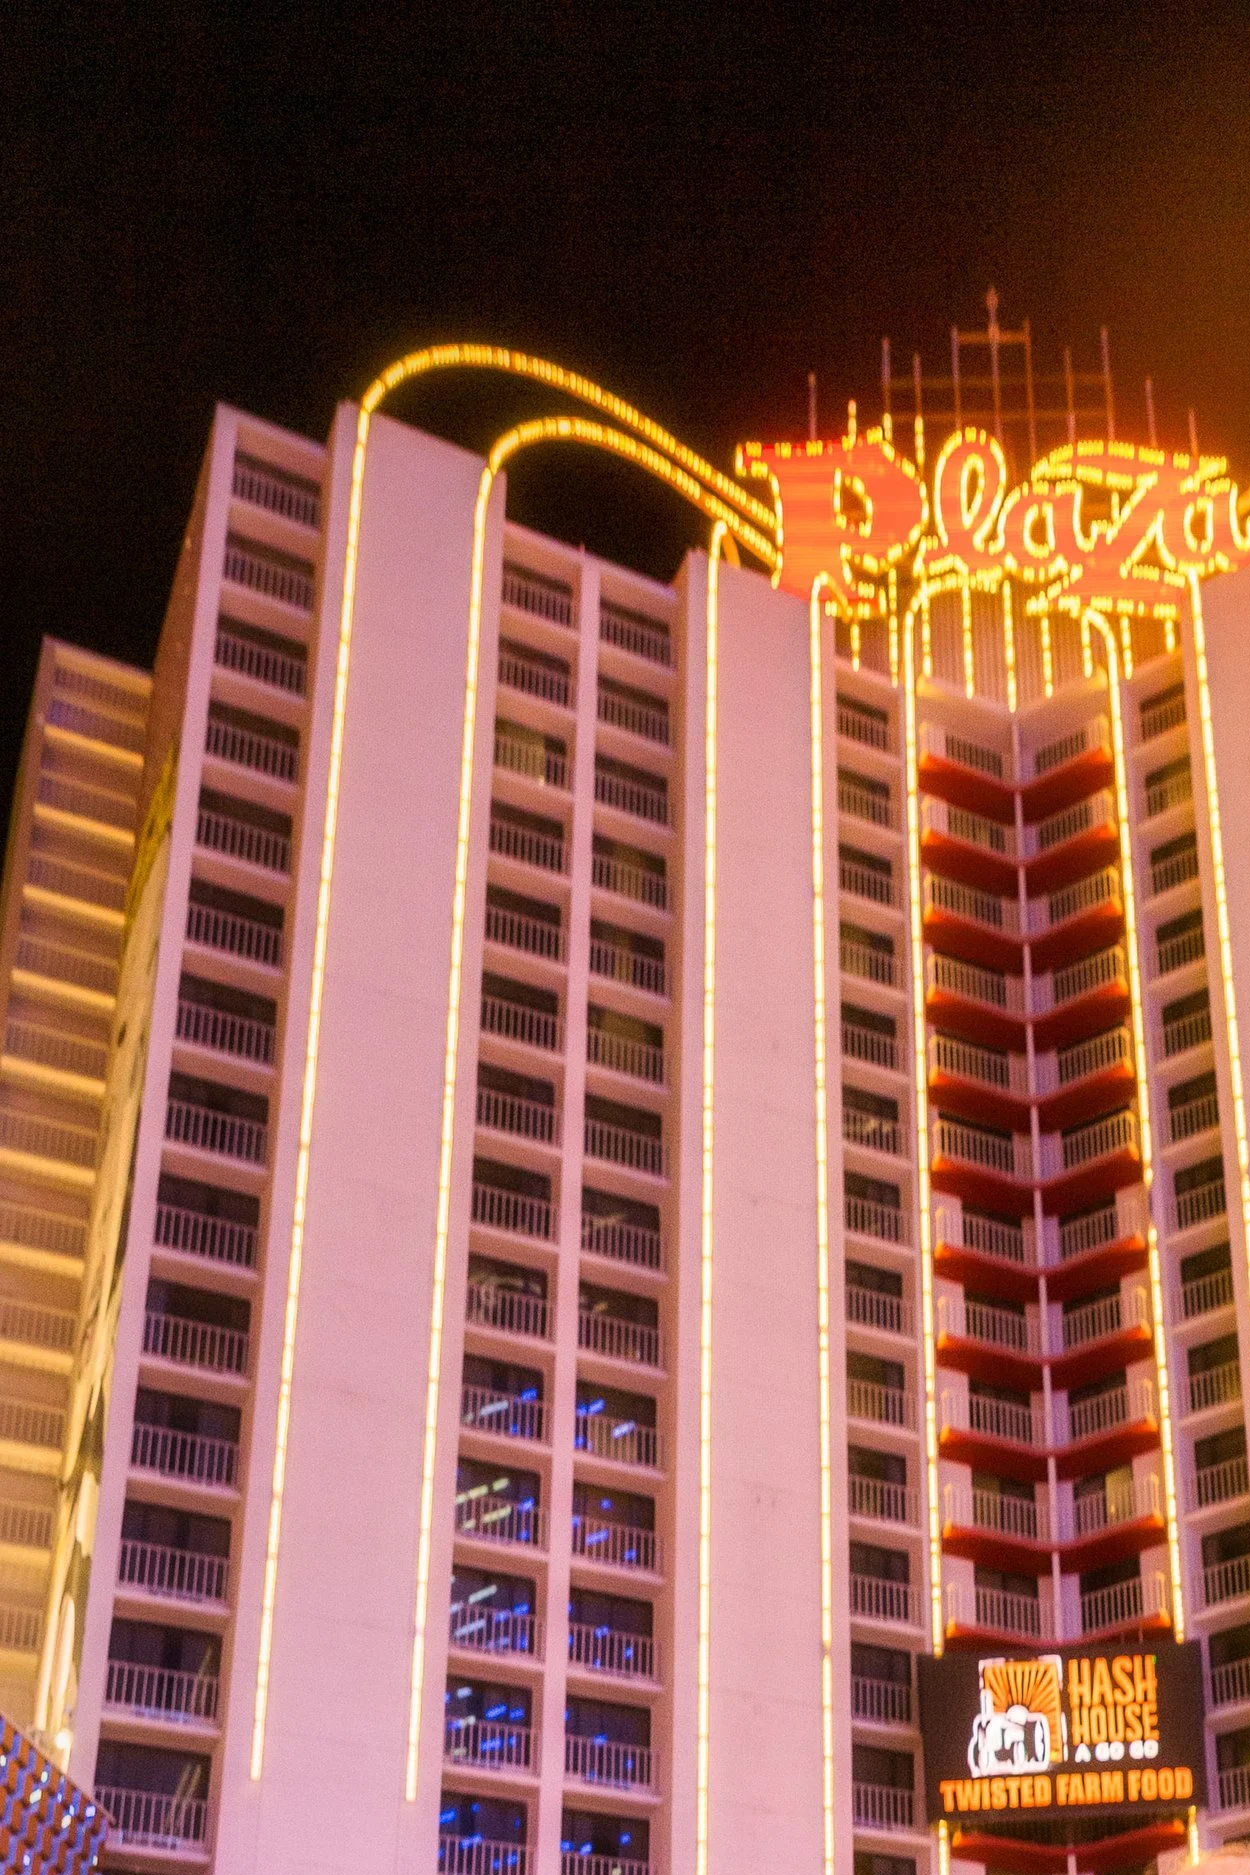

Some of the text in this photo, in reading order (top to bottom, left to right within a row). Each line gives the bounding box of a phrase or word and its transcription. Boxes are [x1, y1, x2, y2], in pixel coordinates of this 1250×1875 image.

[1068, 1654, 1157, 1706] HASH
[1071, 1702, 1159, 1746] HOUSE
[1074, 1743, 1091, 1763] A
[940, 1766, 1193, 1813] TWISTED FARM FOOD
